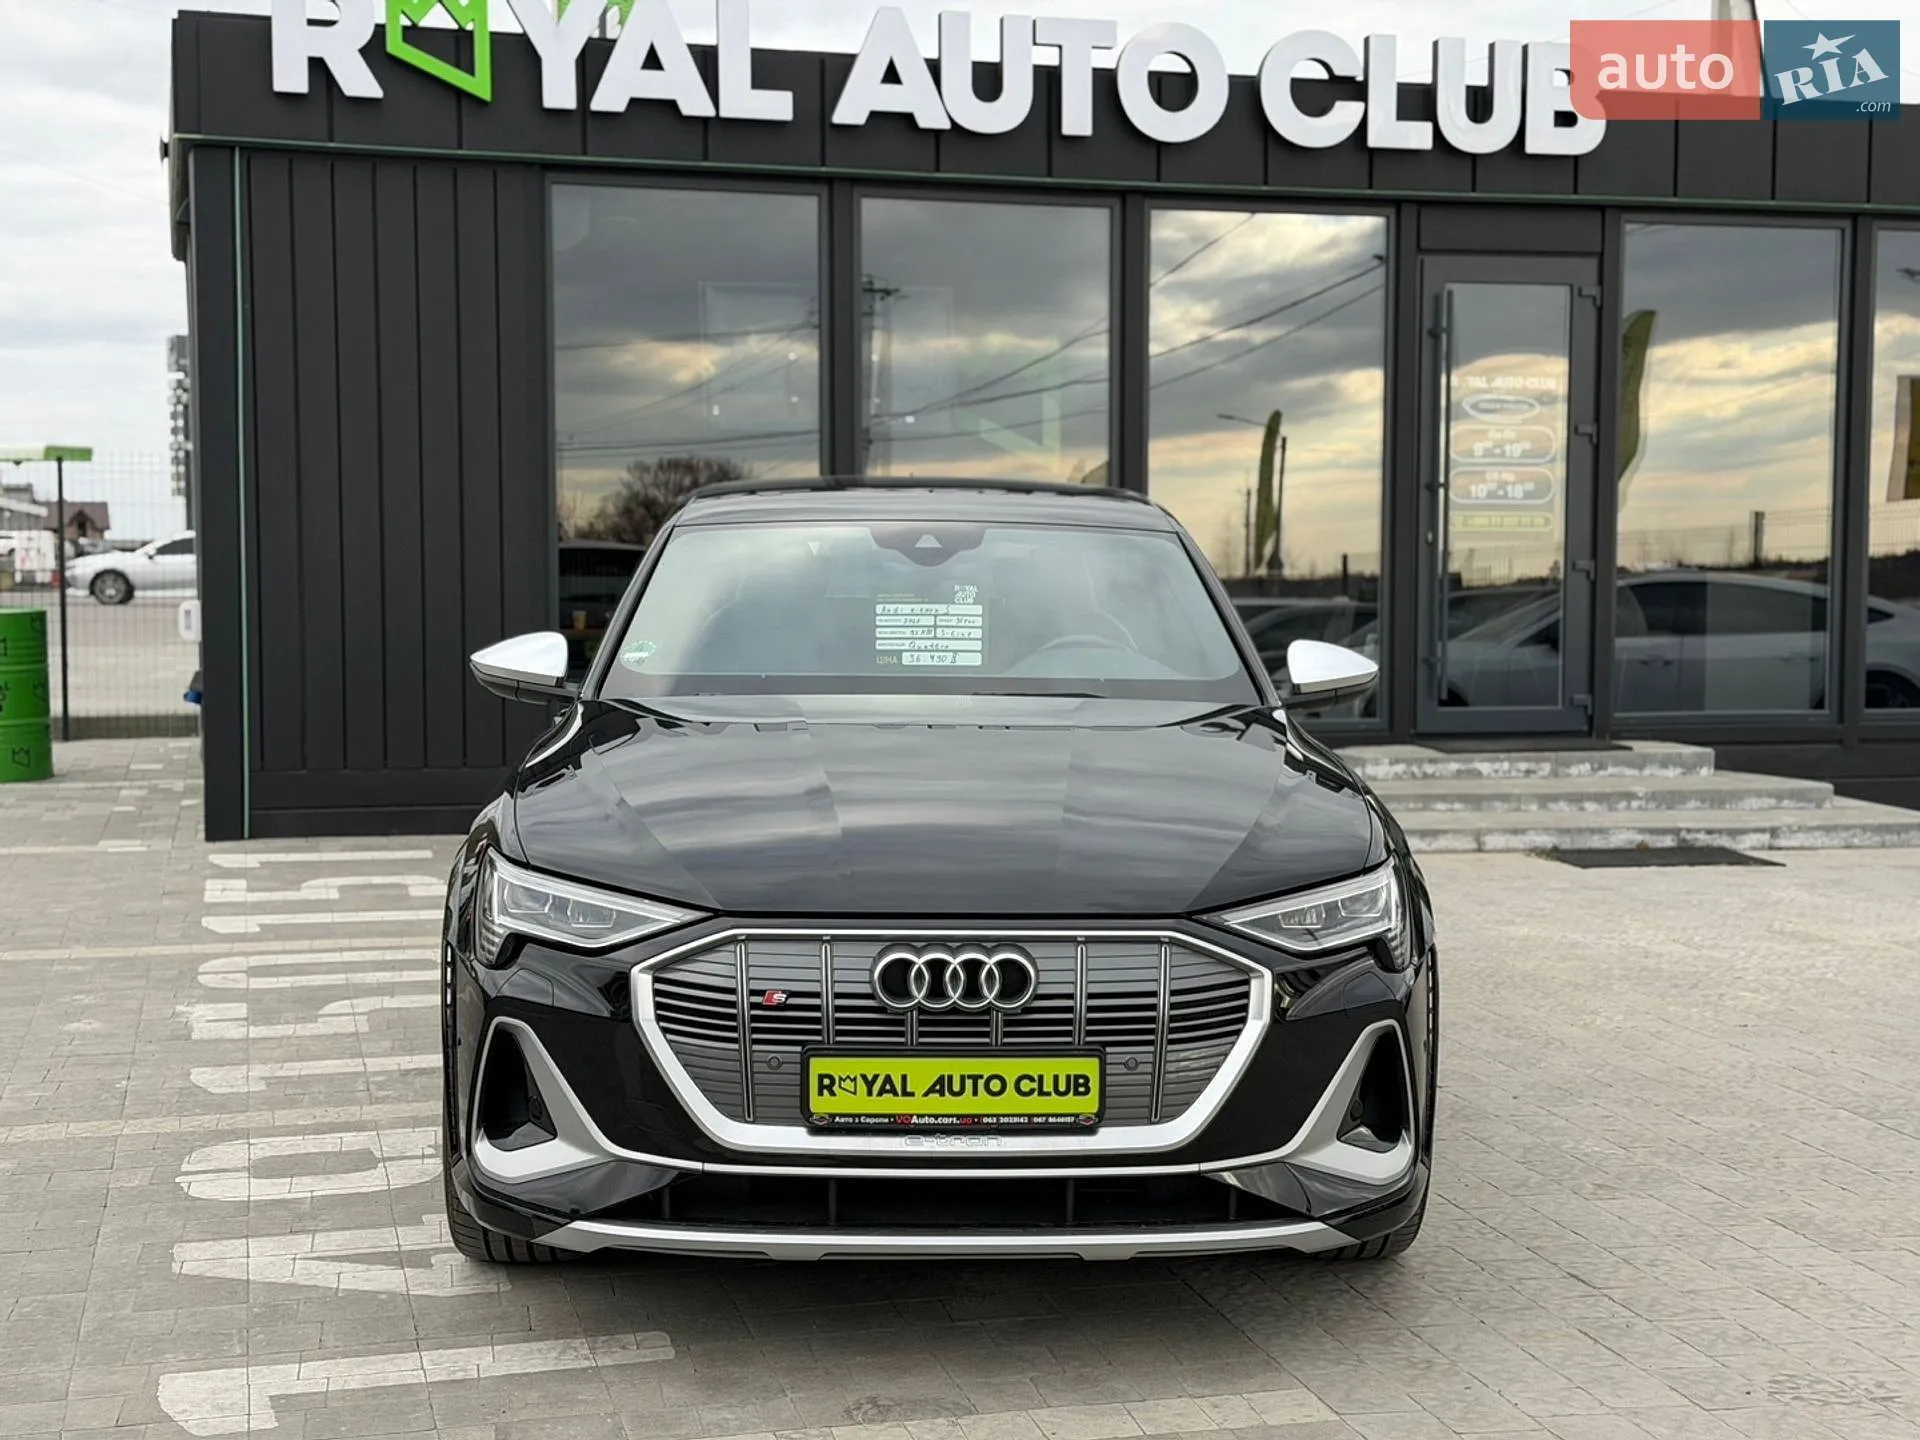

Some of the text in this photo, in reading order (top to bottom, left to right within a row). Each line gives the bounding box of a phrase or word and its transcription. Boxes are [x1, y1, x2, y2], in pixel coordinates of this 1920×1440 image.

[831, 6, 1231, 144] AUTO
[1259, 29, 1607, 158] CLUB
[921, 1073, 1007, 1098] AUTO
[1014, 1073, 1092, 1098] CLUB
[904, 1132, 1004, 1148] e-tron
